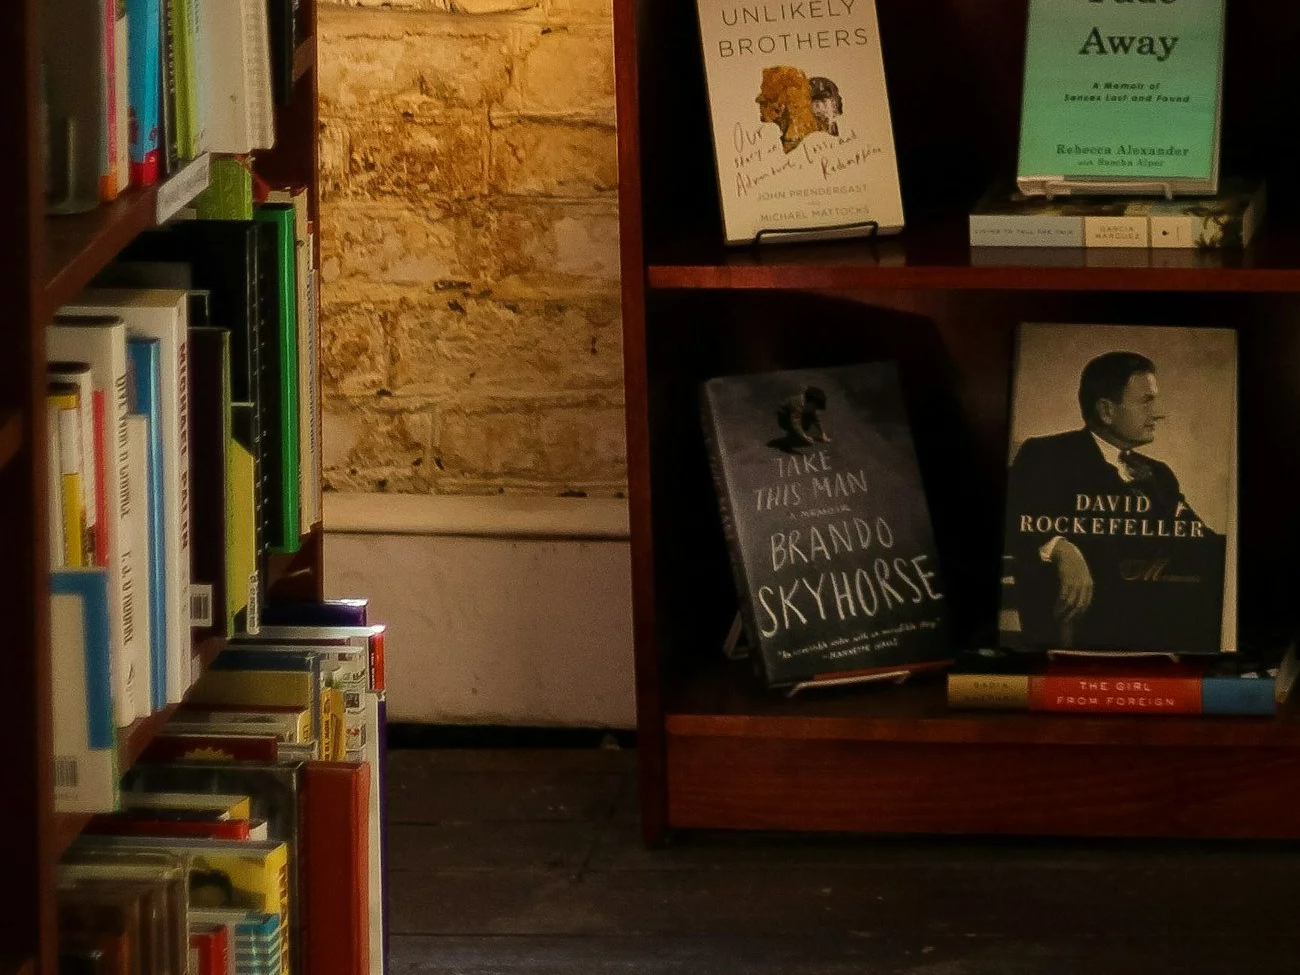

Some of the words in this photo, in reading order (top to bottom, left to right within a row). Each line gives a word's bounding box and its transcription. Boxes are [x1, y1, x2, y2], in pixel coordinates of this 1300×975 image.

[718, 27, 868, 58] BROTHERS
[1079, 26, 1179, 62] Away
[1149, 82, 1161, 90] of
[1064, 93, 1101, 102] Senses
[1156, 95, 1190, 103] Found
[733, 121, 763, 154] Our
[1057, 144, 1112, 155] Rebecca
[1117, 144, 1190, 156] Alexander
[760, 211, 806, 222] MICHAEL
[774, 449, 832, 478] TAKE
[756, 481, 803, 511] THIS
[813, 470, 868, 498] MAN
[1075, 493, 1150, 513] DAVID
[1019, 515, 1204, 538] ROCKEFELLER
[770, 516, 895, 572] BRANDO
[757, 554, 944, 639] SKYHORSE
[1079, 681, 1108, 691] THE
[1115, 682, 1151, 692] GIRL
[1056, 696, 1098, 705] FROM
[1105, 697, 1175, 706] FOREIGN
